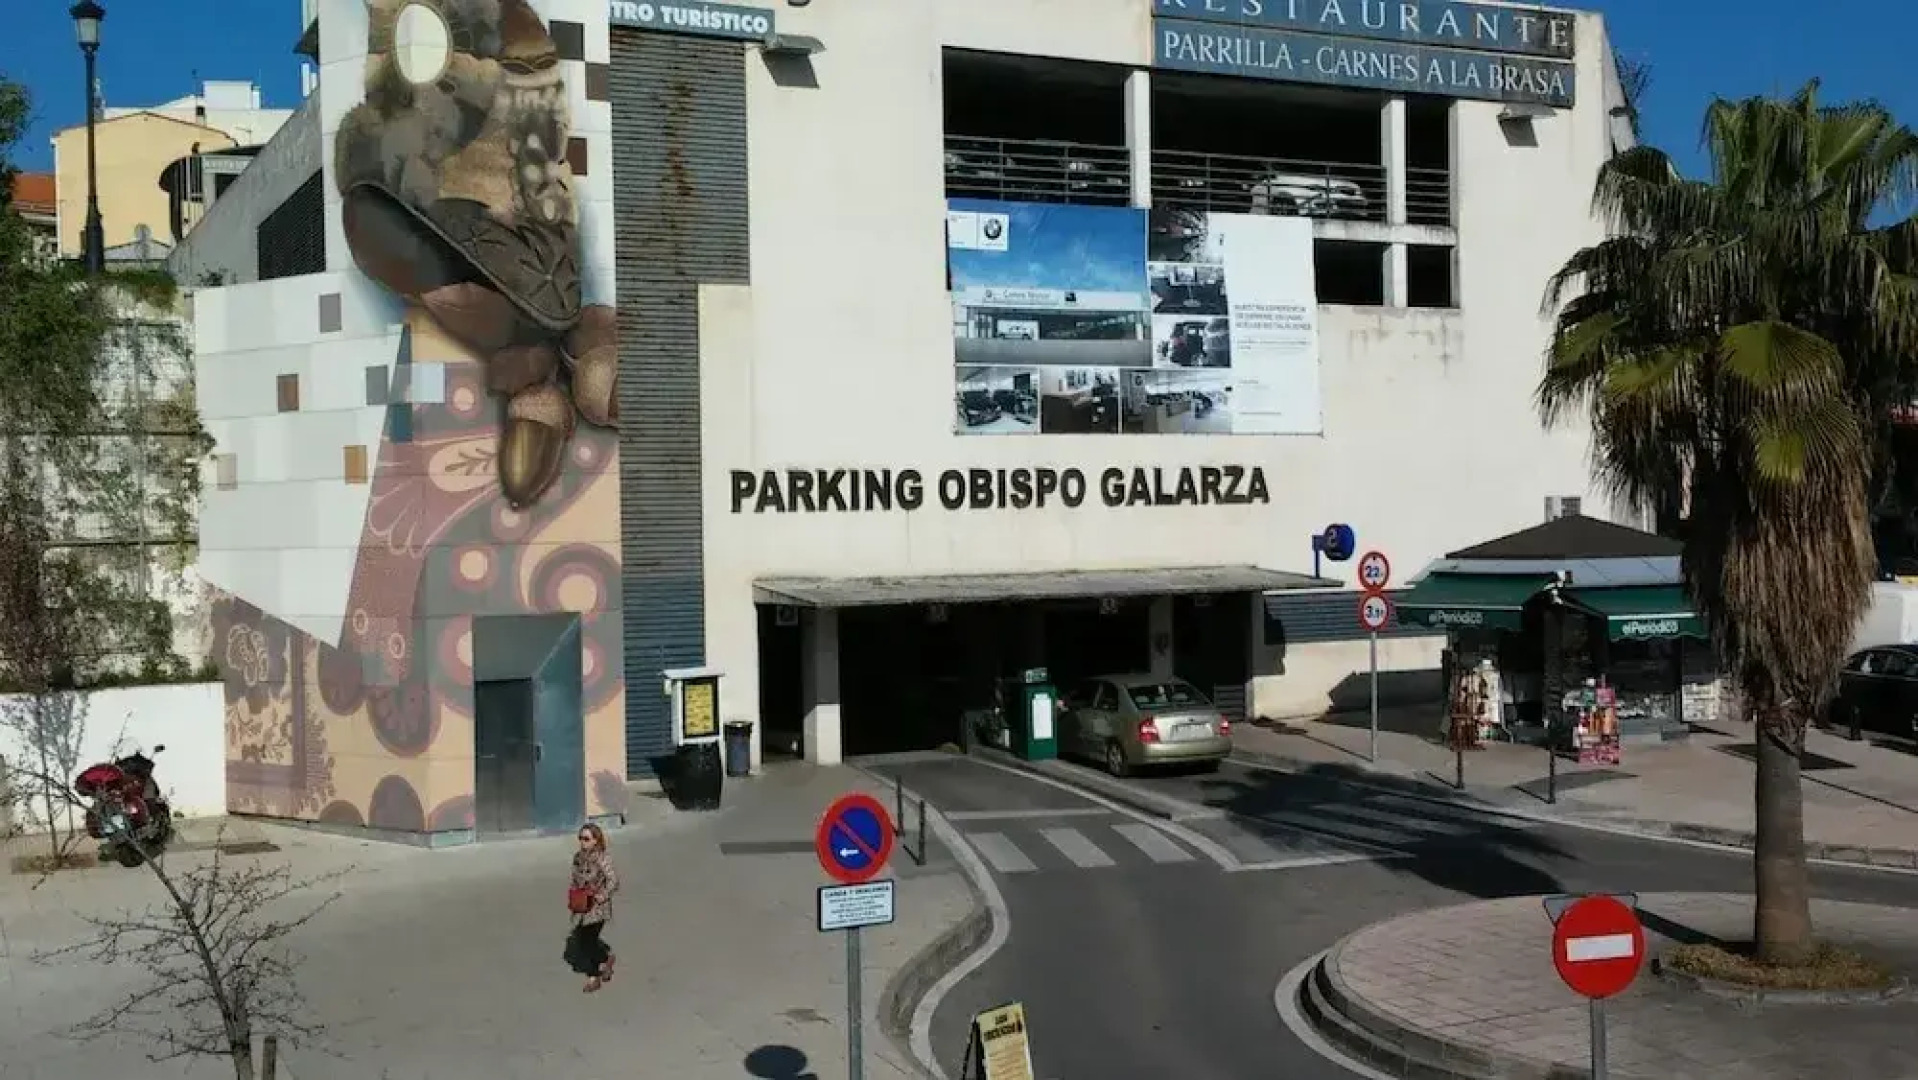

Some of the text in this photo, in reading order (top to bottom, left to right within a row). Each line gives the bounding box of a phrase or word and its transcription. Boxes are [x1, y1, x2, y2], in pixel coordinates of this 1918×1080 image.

[660, 6, 769, 34] TURÍSTICO
[1164, 30, 1294, 70] PARRILLA
[1315, 45, 1419, 81] CARNES
[1426, 58, 1444, 85] A
[1451, 60, 1482, 89] LA
[1489, 64, 1566, 97] BRASA
[730, 465, 1271, 513] PARKING OBISPO GALARZA
